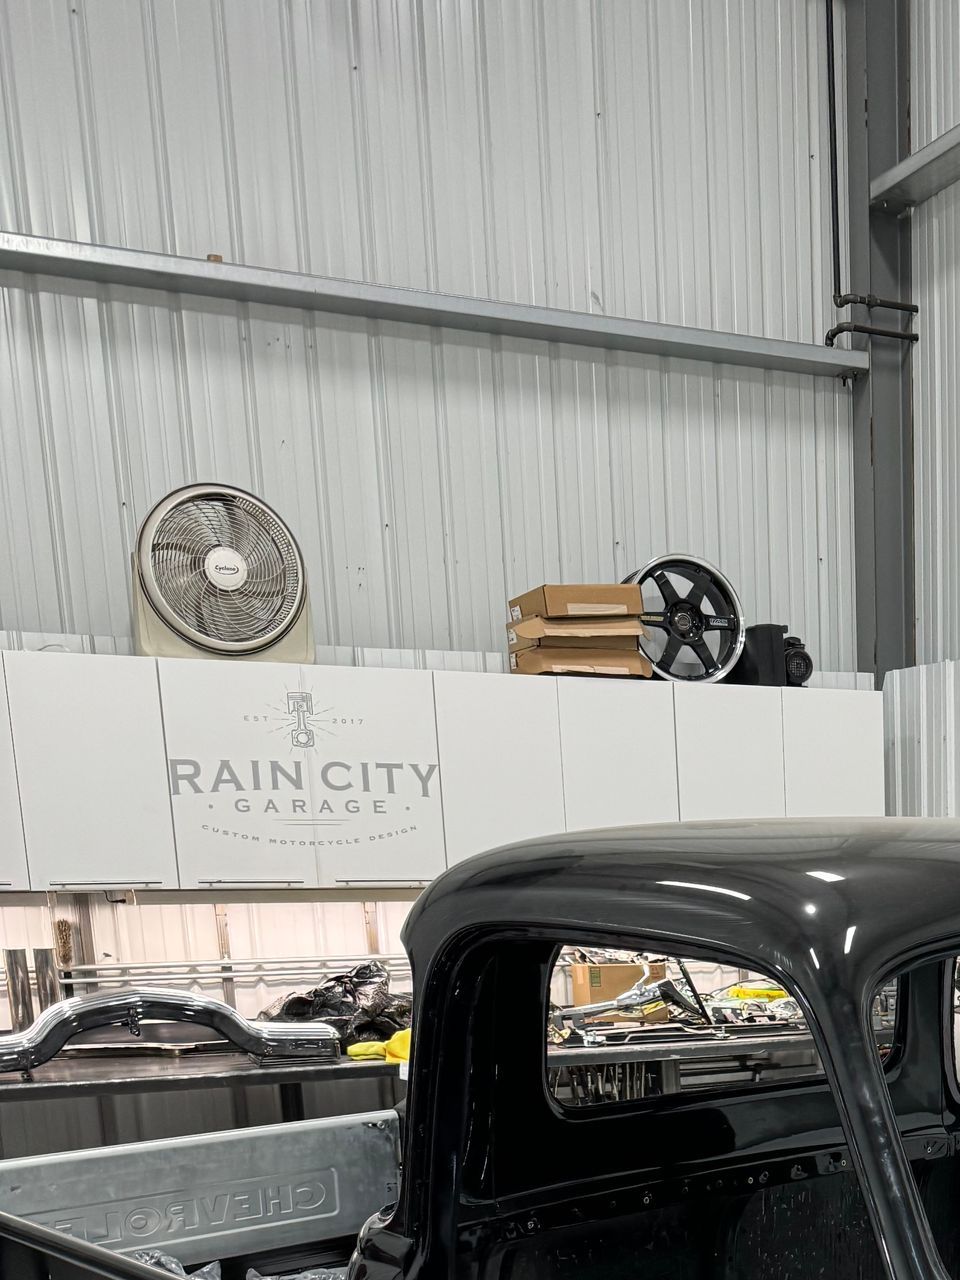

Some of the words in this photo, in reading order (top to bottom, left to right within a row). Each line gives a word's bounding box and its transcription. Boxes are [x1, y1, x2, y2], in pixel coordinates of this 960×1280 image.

[244, 715, 269, 723] EST
[168, 759, 305, 796] RAIN
[321, 761, 440, 798] CITY
[235, 798, 388, 814] GARAGE
[202, 824, 261, 842] CUSTOM
[269, 838, 361, 847] MOTORCYCLE
[369, 825, 419, 842] DESIGN
